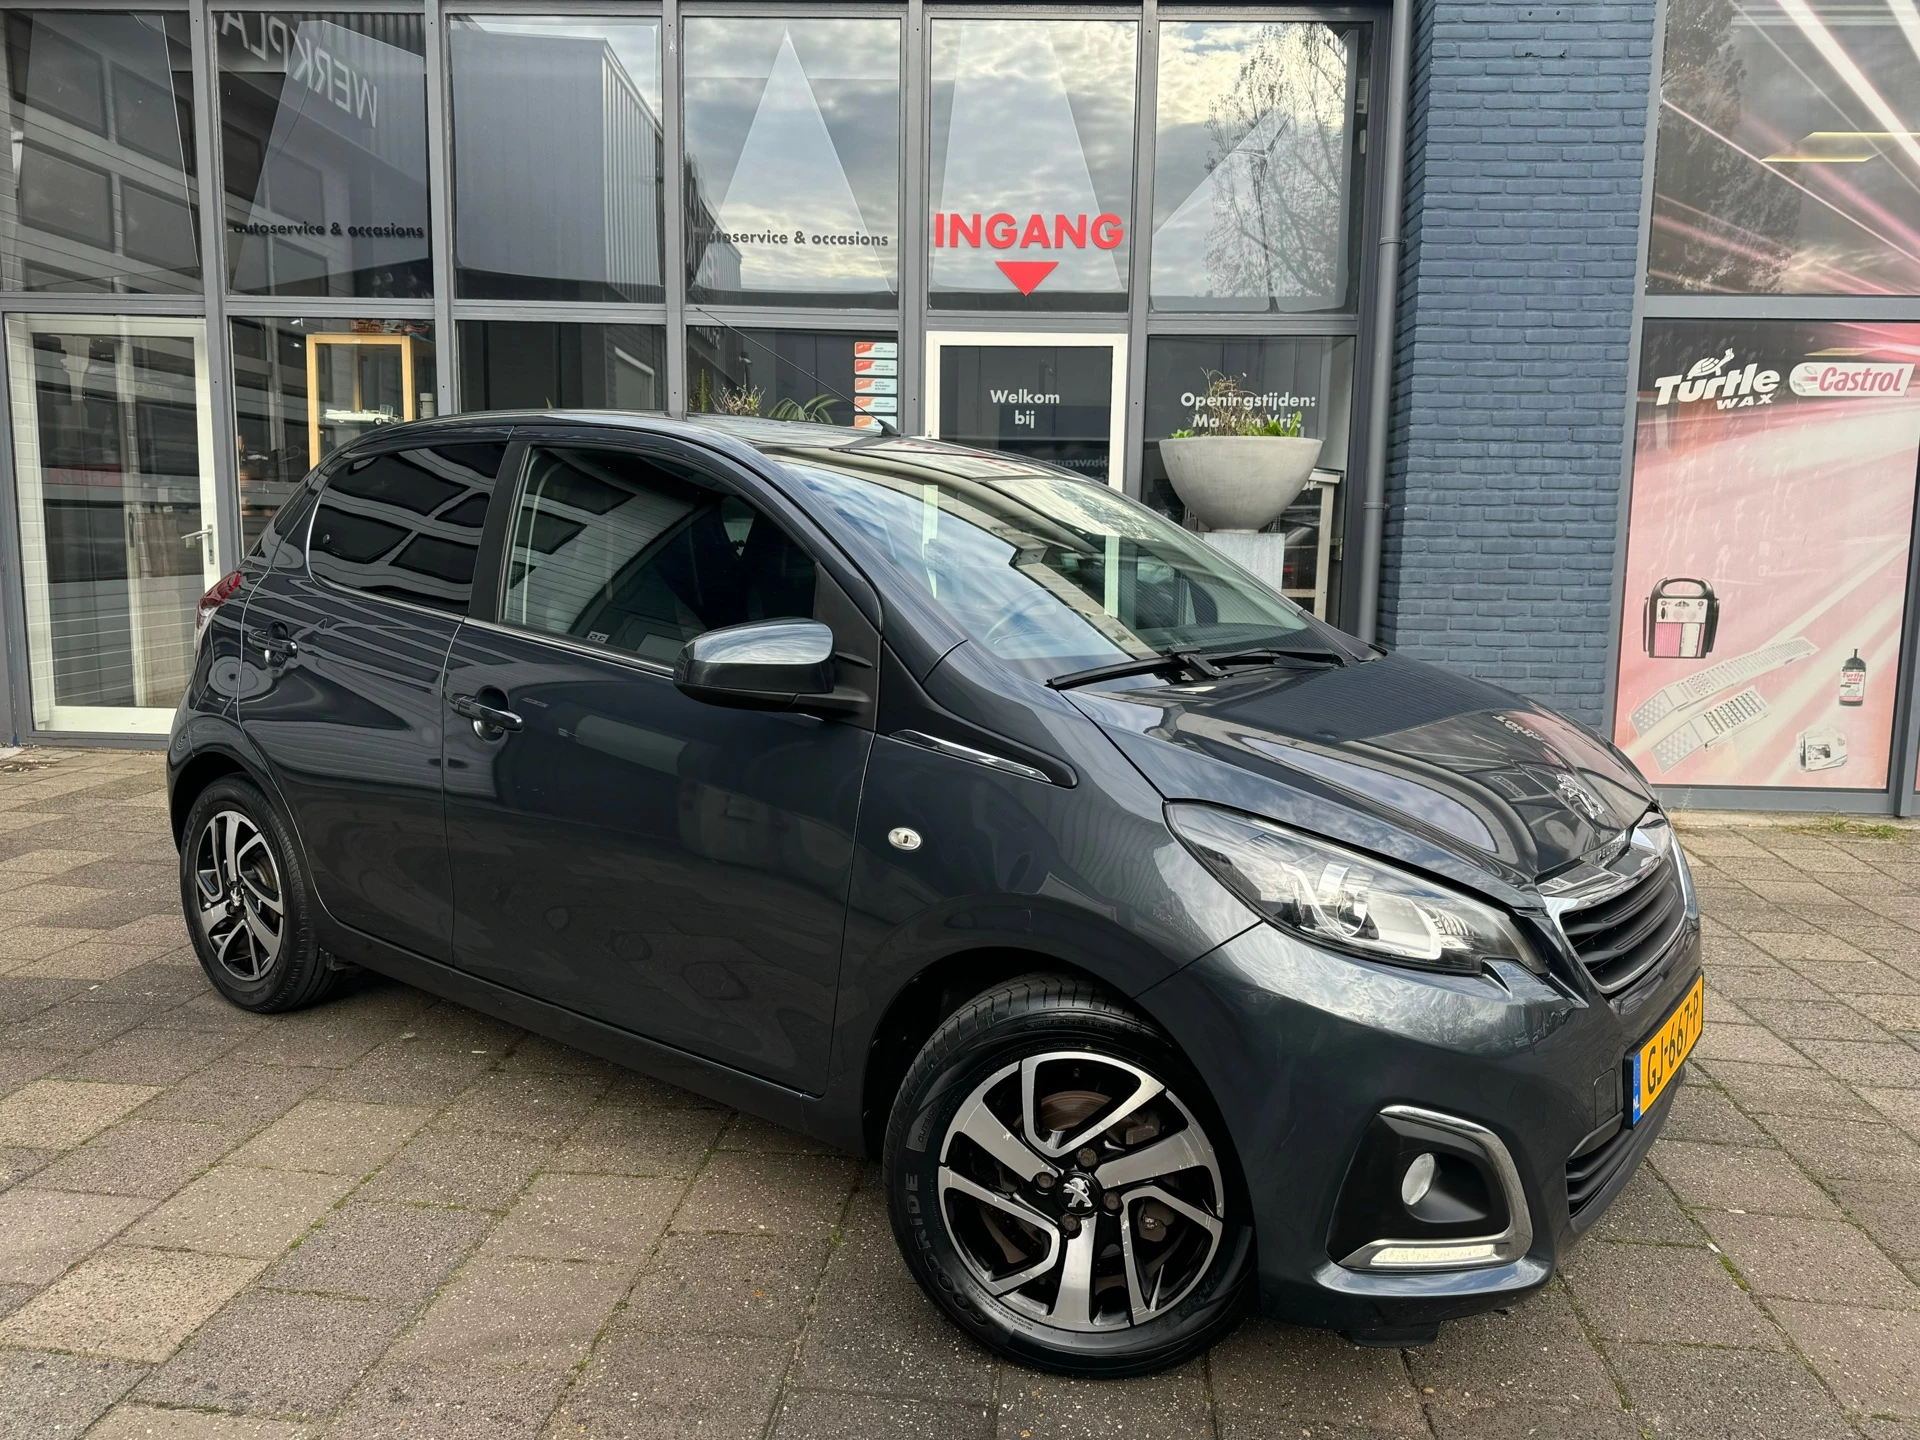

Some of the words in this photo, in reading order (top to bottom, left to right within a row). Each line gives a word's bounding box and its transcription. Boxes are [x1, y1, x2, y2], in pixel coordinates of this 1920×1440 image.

[233, 221, 325, 236] autoservice
[330, 222, 343, 236] &
[347, 223, 424, 238] occasions
[695, 230, 788, 244] autoservice
[794, 230, 806, 244] &
[811, 231, 889, 246] occasions
[935, 213, 1124, 249] INGANG
[1654, 363, 1780, 406] Turtle
[1819, 366, 1904, 392] Castrol
[990, 389, 1060, 404] Welkom
[1181, 392, 1316, 411] Openingstijden:
[1716, 393, 1774, 410] WAX
[1014, 410, 1035, 428] bij
[1647, 989, 1699, 1095] GJ-667-P
[1633, 1094, 1640, 1109] NL
